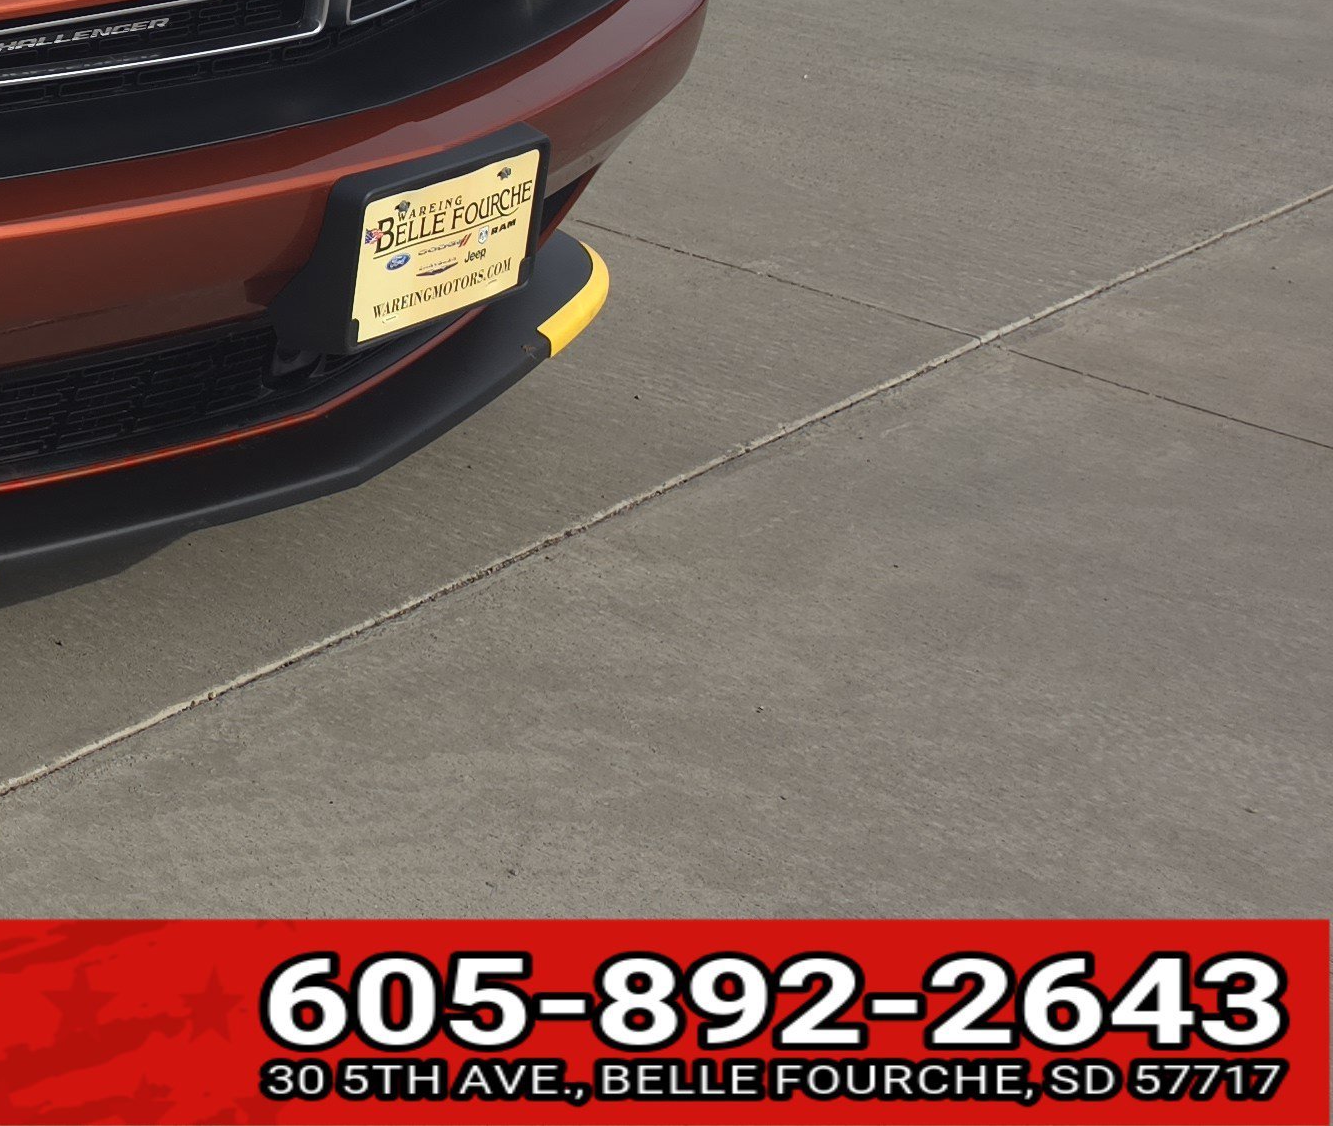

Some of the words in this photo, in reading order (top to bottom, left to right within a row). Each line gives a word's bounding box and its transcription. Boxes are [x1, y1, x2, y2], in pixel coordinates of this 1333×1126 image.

[374, 209, 447, 254] BELLE
[451, 179, 533, 231] FOURCHE
[397, 194, 464, 221] WAREING
[490, 218, 517, 235] RAM
[464, 247, 487, 263] Jeep
[373, 257, 513, 320] WAREINGMOTORS.COM
